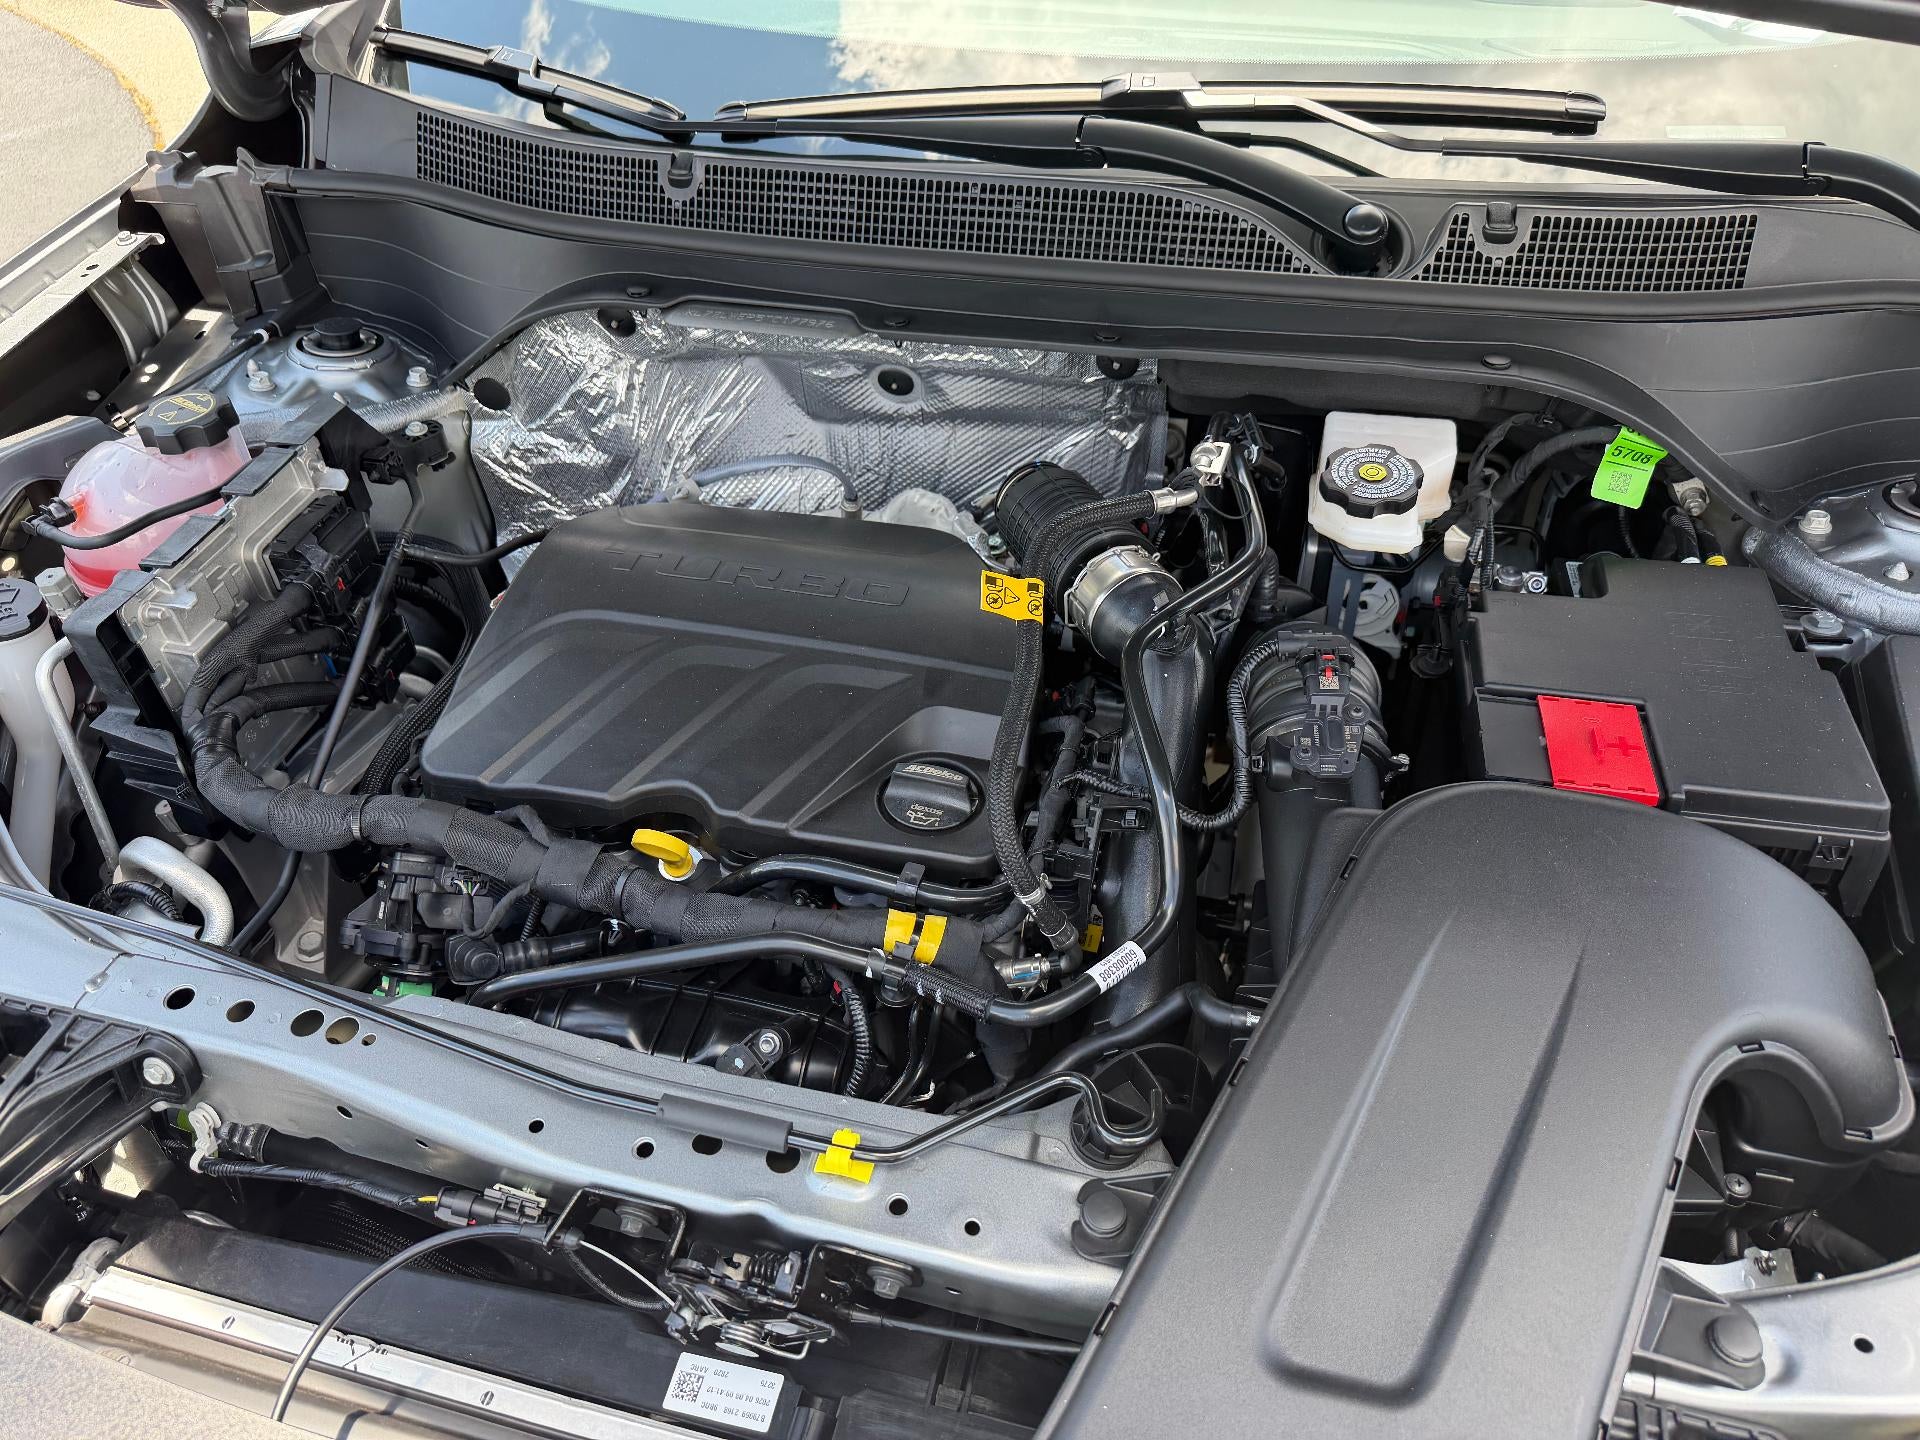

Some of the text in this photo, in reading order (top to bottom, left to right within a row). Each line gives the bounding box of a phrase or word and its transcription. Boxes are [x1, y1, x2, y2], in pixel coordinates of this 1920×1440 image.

[1611, 445, 1654, 464] 5708
[607, 549, 910, 606] TURBO
[902, 764, 964, 780] ACDelco
